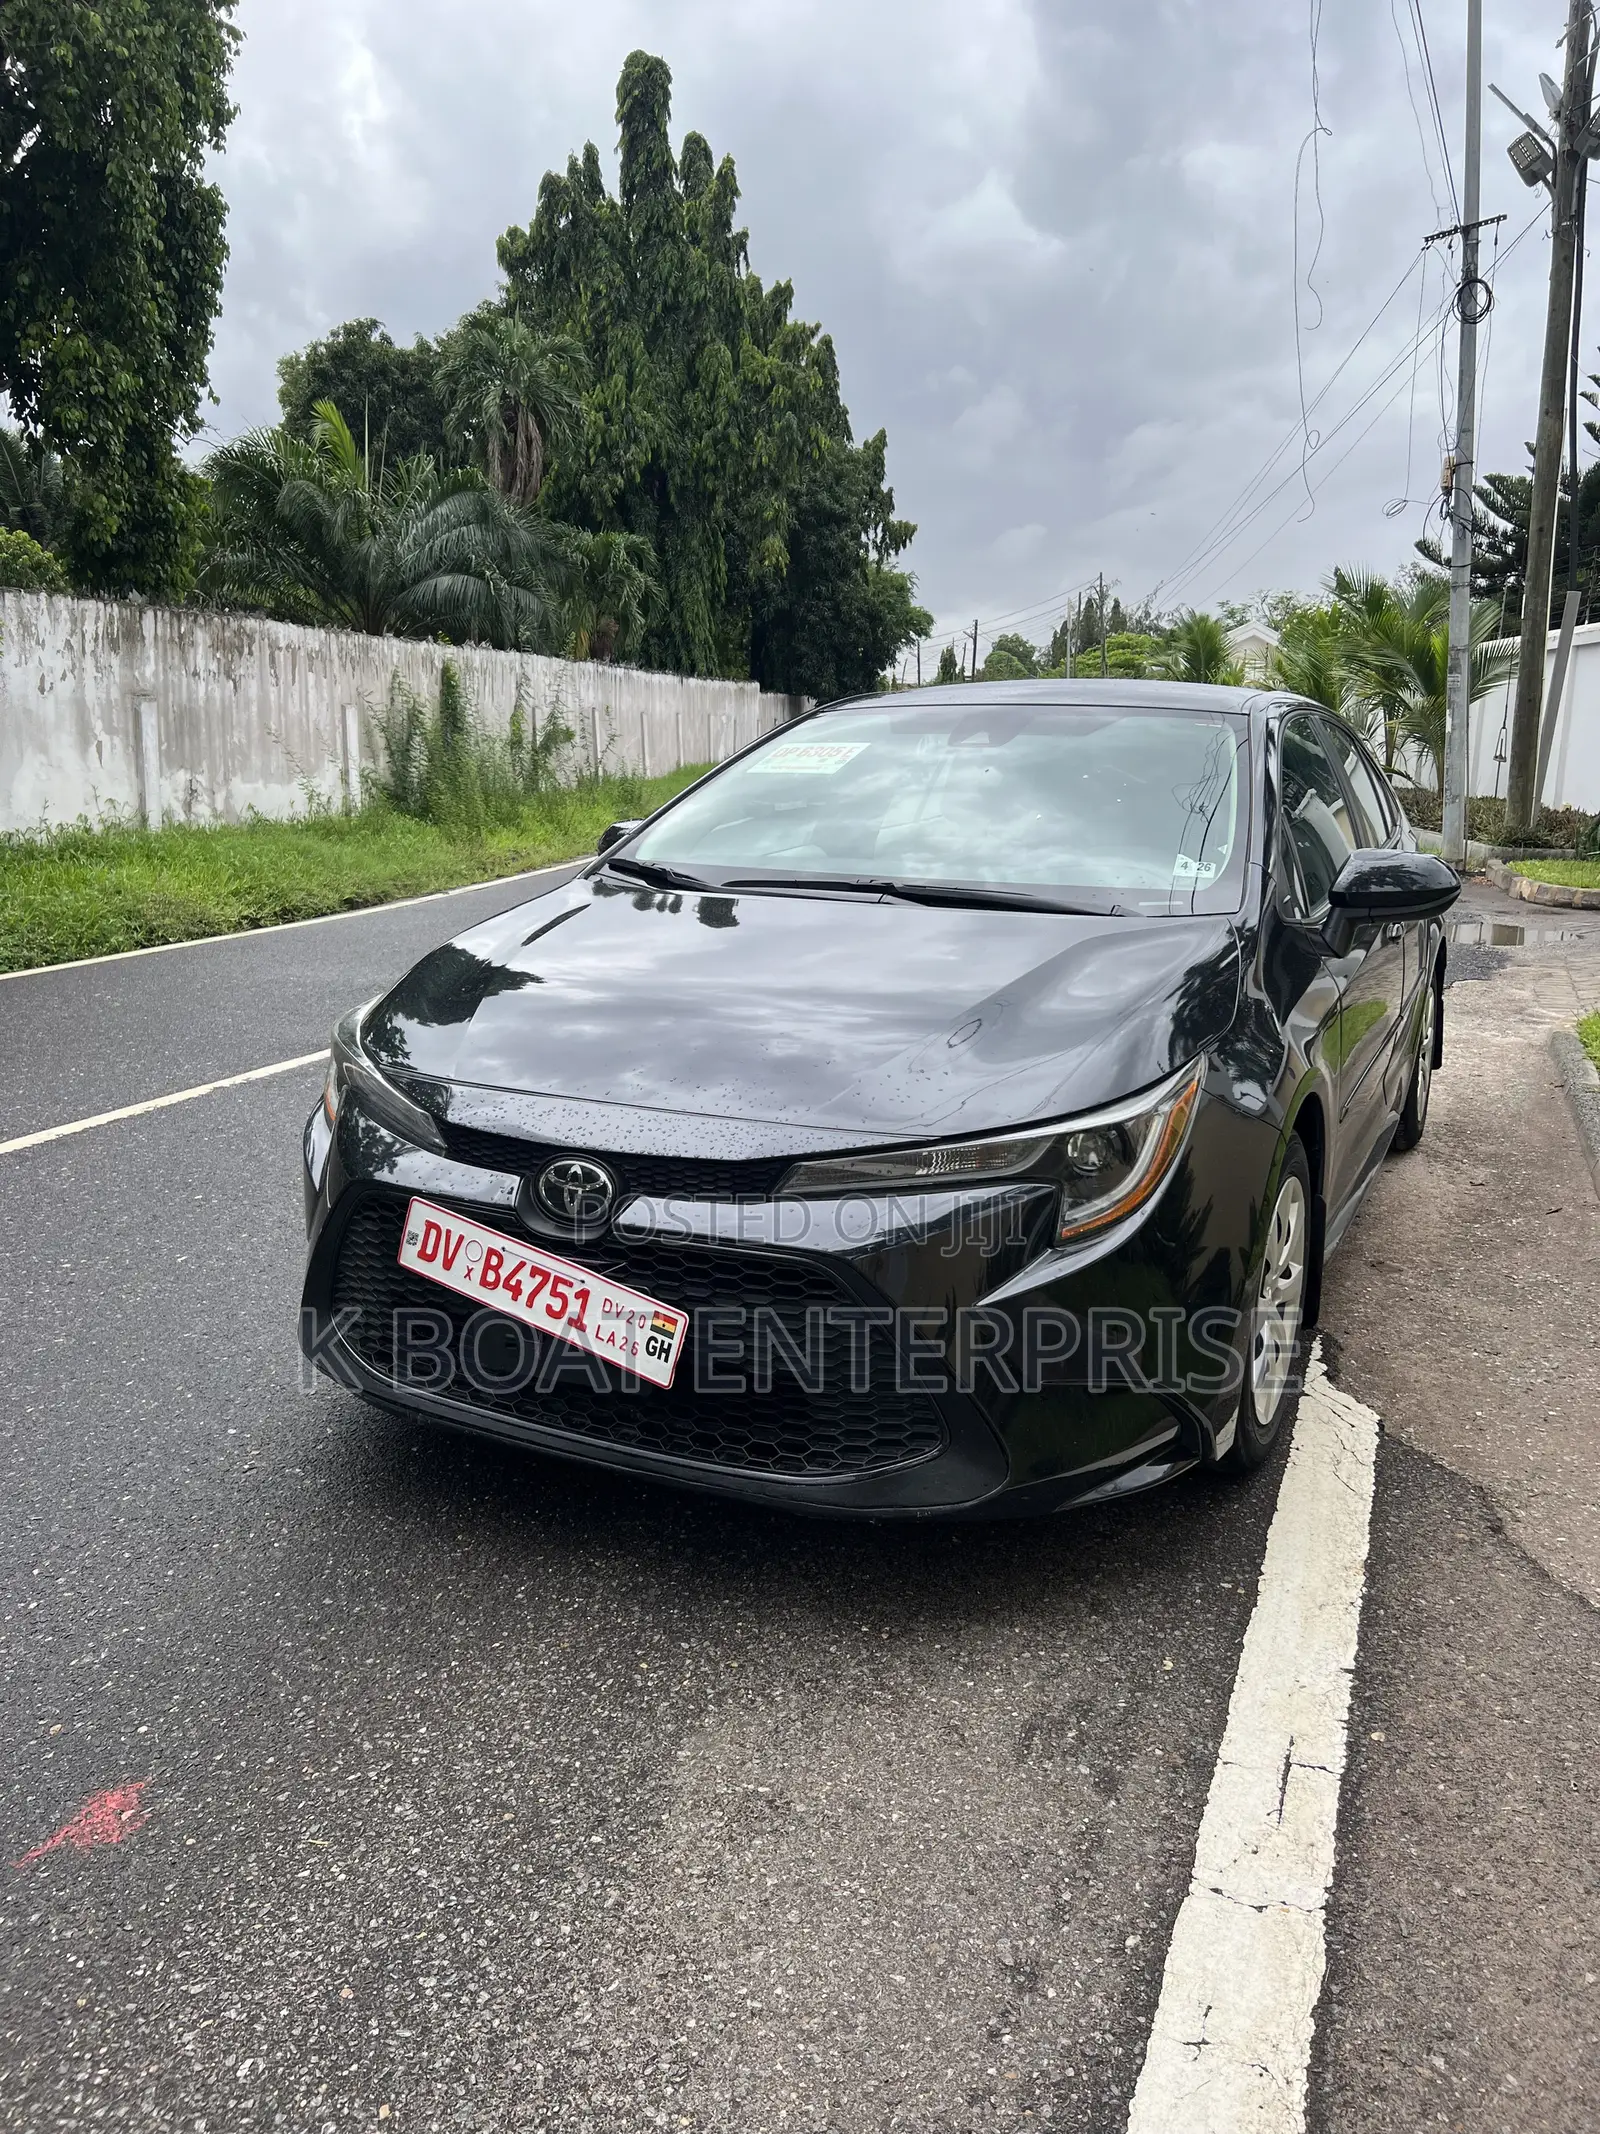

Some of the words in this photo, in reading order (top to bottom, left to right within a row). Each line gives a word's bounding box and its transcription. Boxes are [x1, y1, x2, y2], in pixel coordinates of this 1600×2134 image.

[1180, 861, 1188, 870] 4
[1197, 862, 1211, 872] 26
[417, 1219, 465, 1271] DV
[479, 1246, 591, 1333] B4751
[645, 1335, 673, 1363] GH
